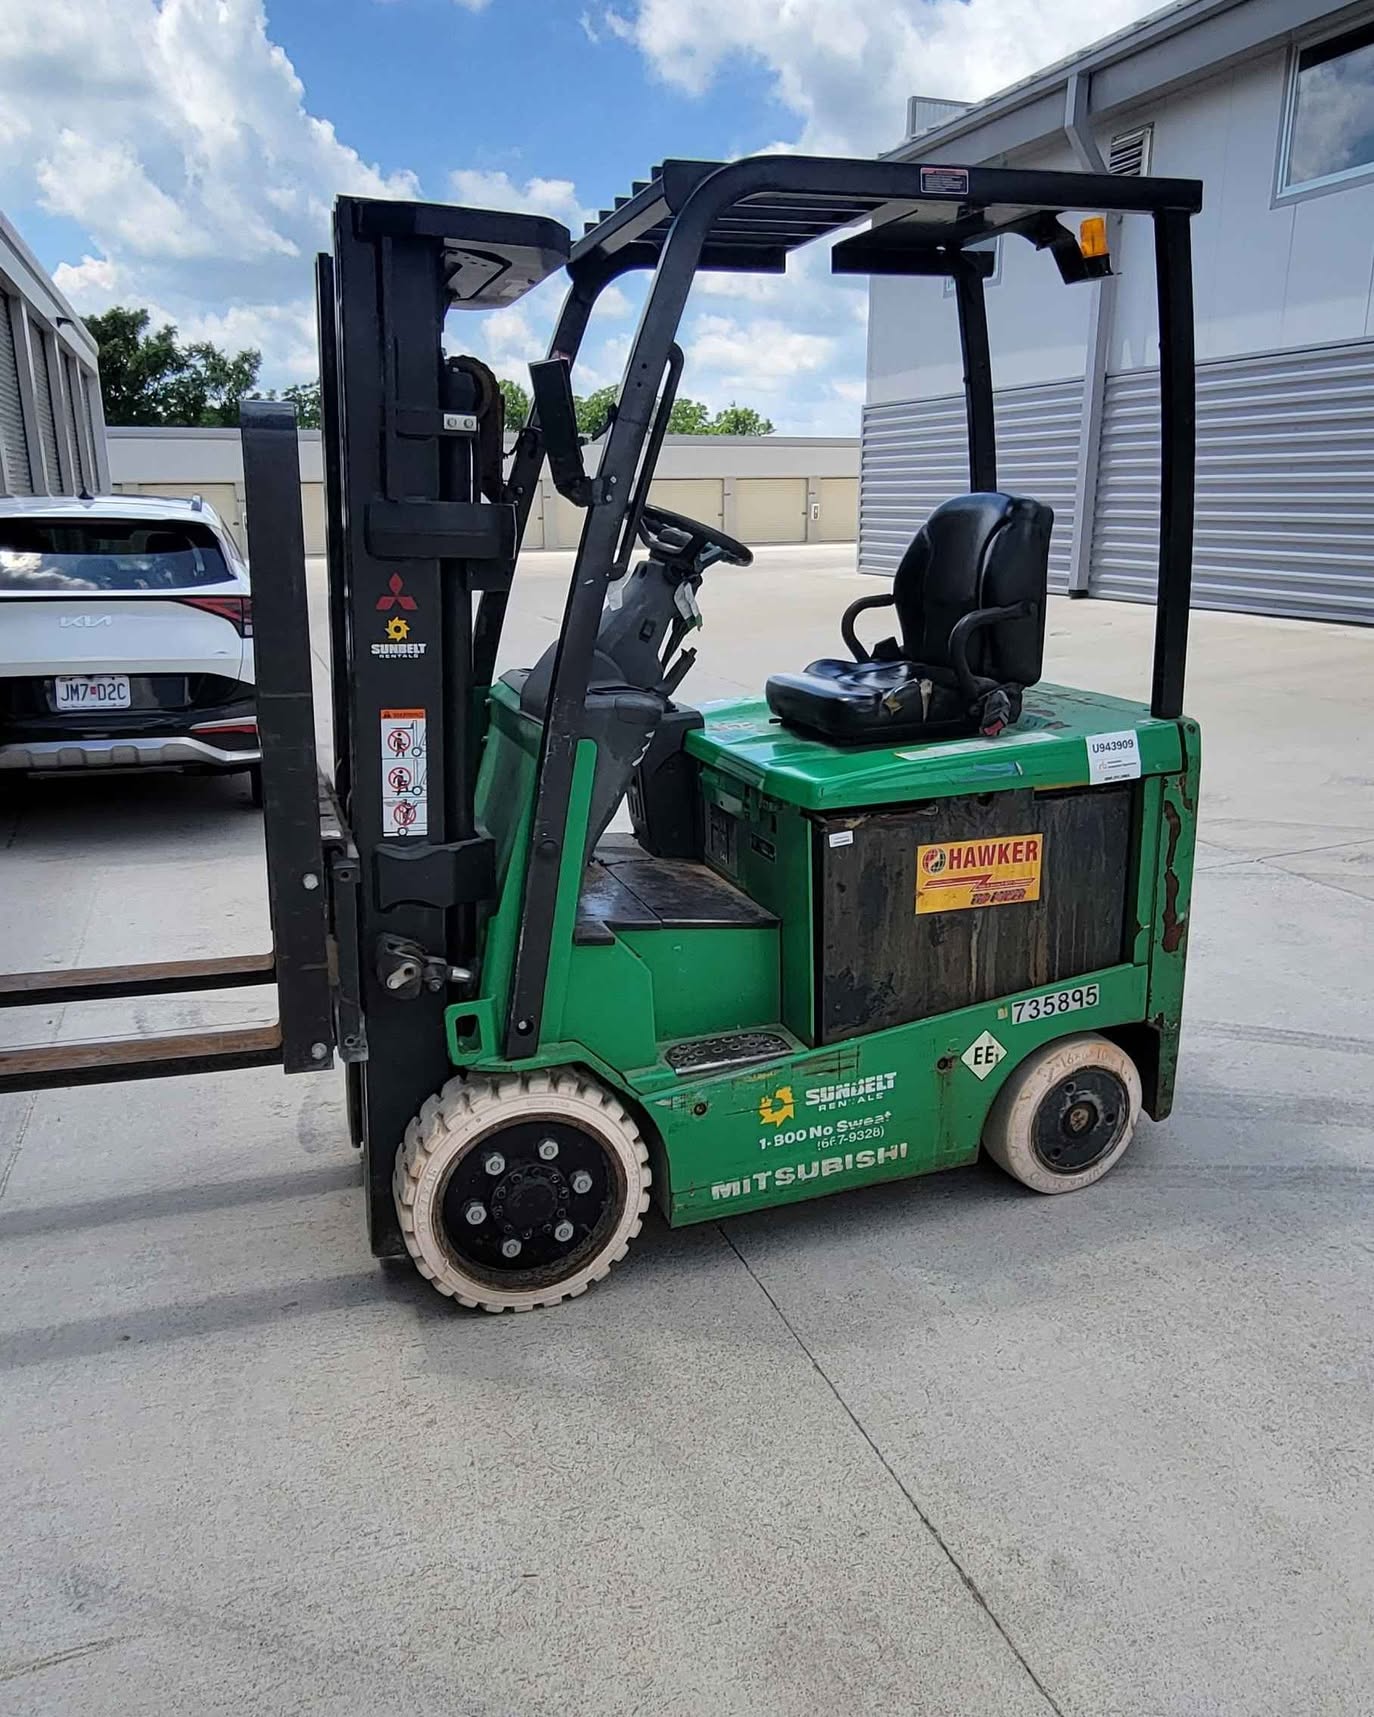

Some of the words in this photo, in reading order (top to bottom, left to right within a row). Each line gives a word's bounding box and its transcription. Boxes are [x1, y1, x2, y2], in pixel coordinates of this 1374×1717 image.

[60, 616, 111, 628] KIA
[371, 643, 426, 654] SUNBELT
[61, 683, 88, 701] JM7
[97, 683, 126, 700] D2C
[1092, 739, 1134, 753] U943909
[948, 840, 1038, 870] HAWKER
[1014, 986, 1097, 1023] 735895
[818, 1092, 884, 1112] RENALS
[759, 1130, 807, 1150] 1-800
[809, 1125, 834, 1139] No
[836, 1111, 892, 1133] Sweat
[711, 1143, 908, 1200] MITSUBISHI
